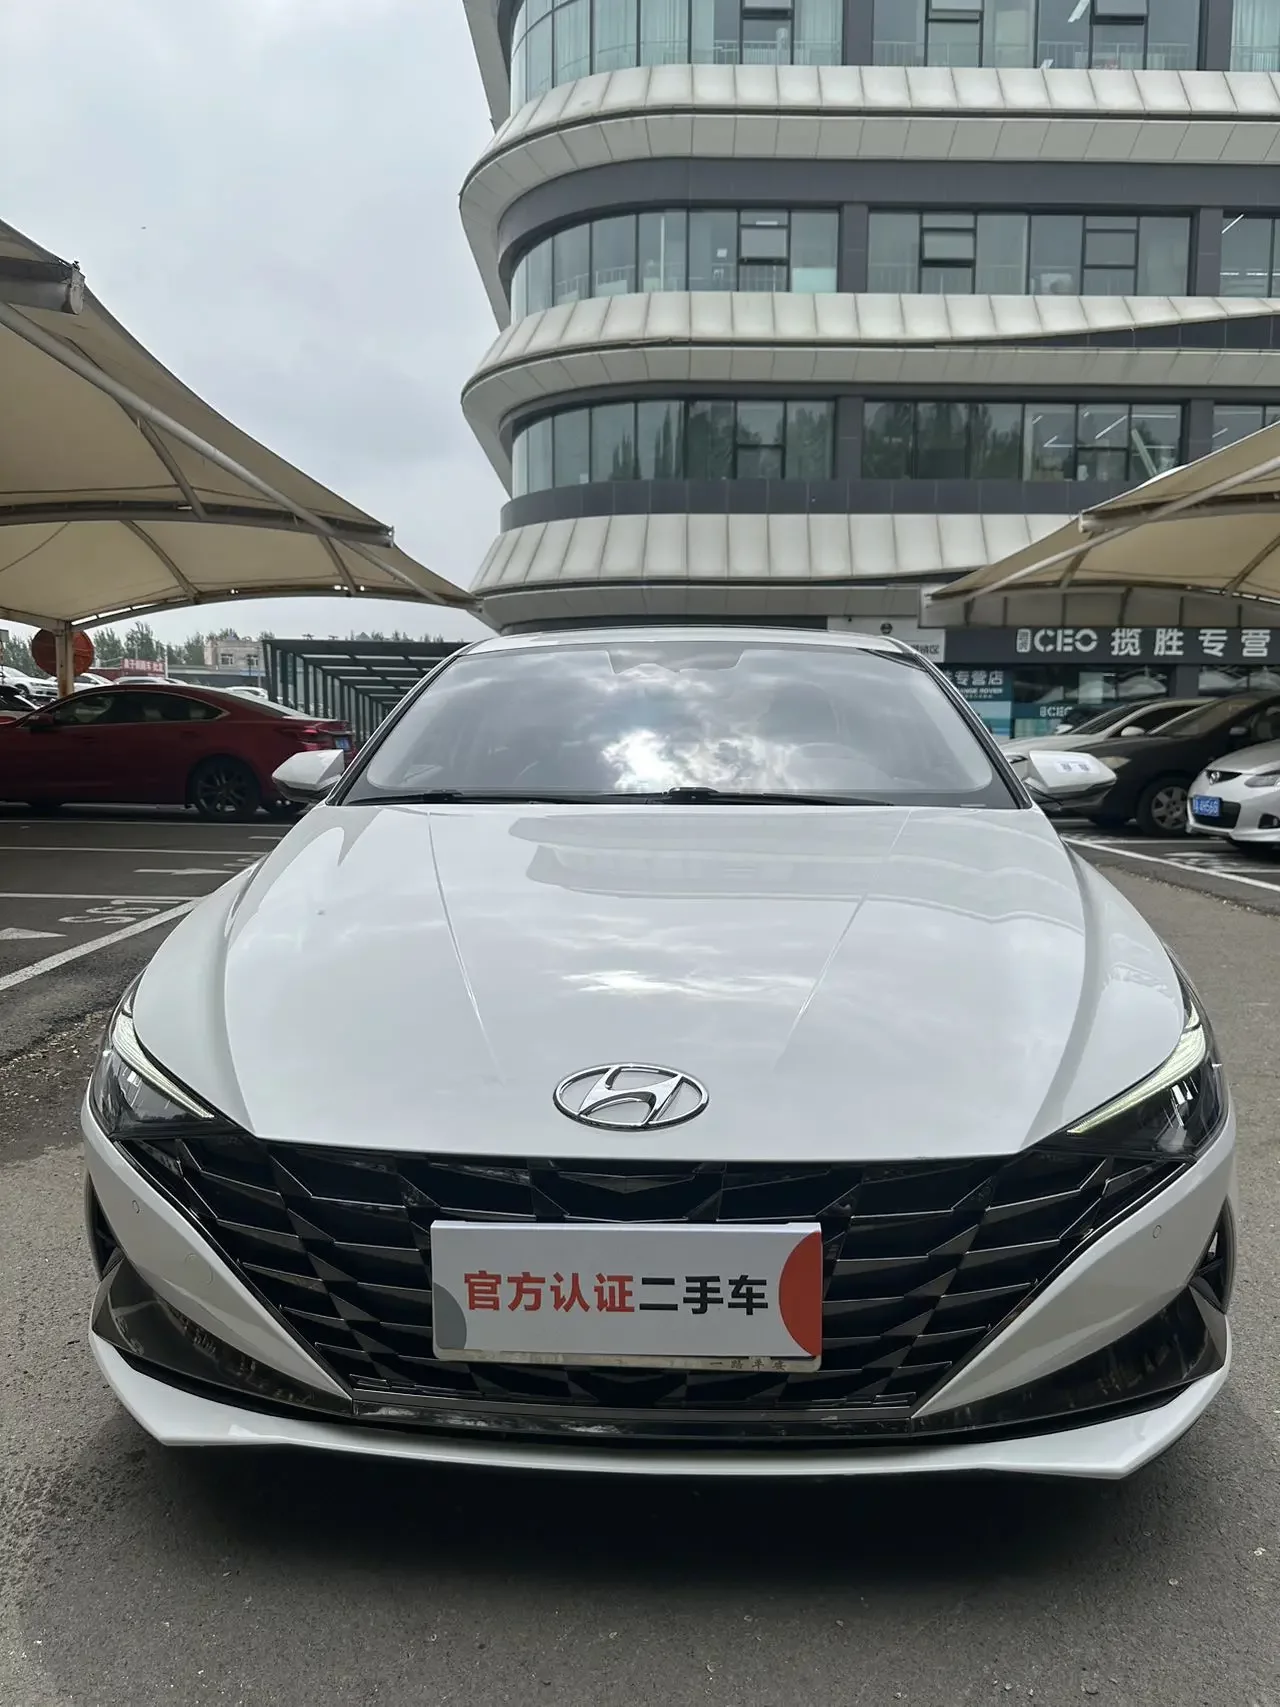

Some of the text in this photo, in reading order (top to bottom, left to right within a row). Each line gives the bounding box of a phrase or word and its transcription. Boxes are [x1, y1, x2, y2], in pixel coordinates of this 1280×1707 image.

[1033, 628, 1098, 652] CEO
[1110, 627, 1271, 657] 揽胜专营
[463, 1270, 769, 1316] 官方认证二手车
